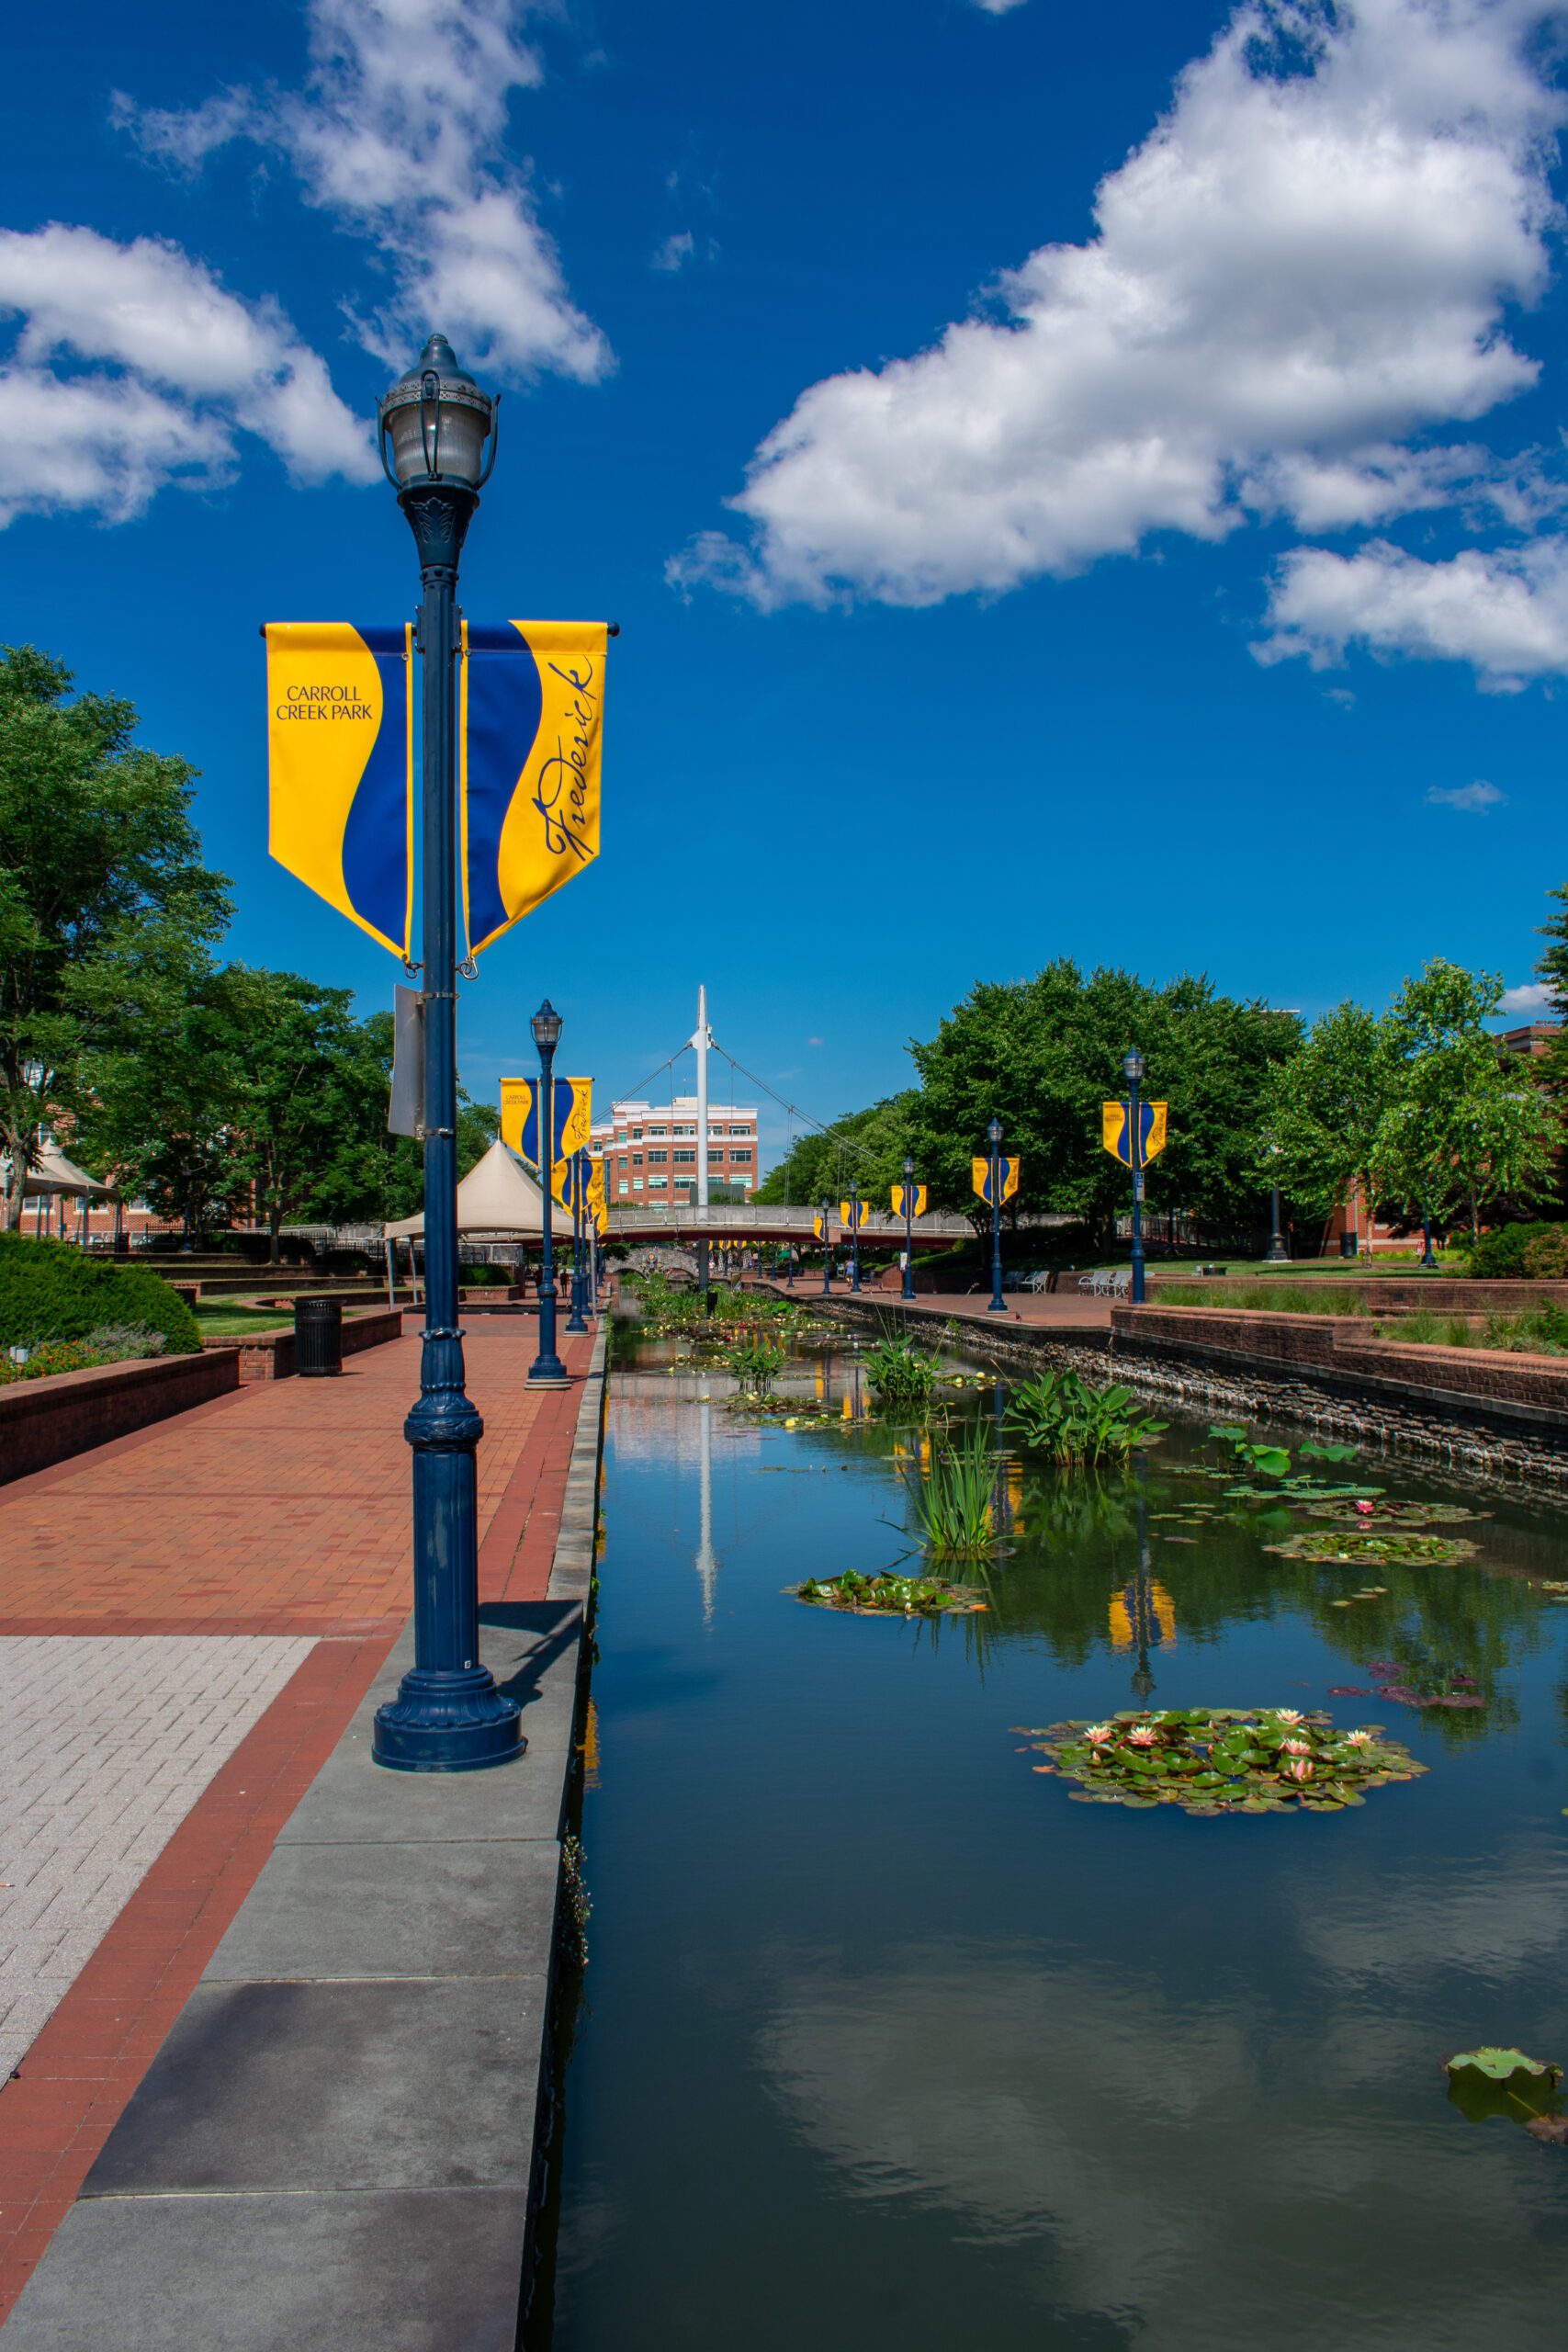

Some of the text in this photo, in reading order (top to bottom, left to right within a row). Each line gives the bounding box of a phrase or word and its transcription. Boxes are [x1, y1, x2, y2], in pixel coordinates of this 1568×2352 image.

[287, 685, 362, 702] CARROLL
[276, 705, 373, 720] CREEK PARK
[532, 654, 597, 862] Frederick
